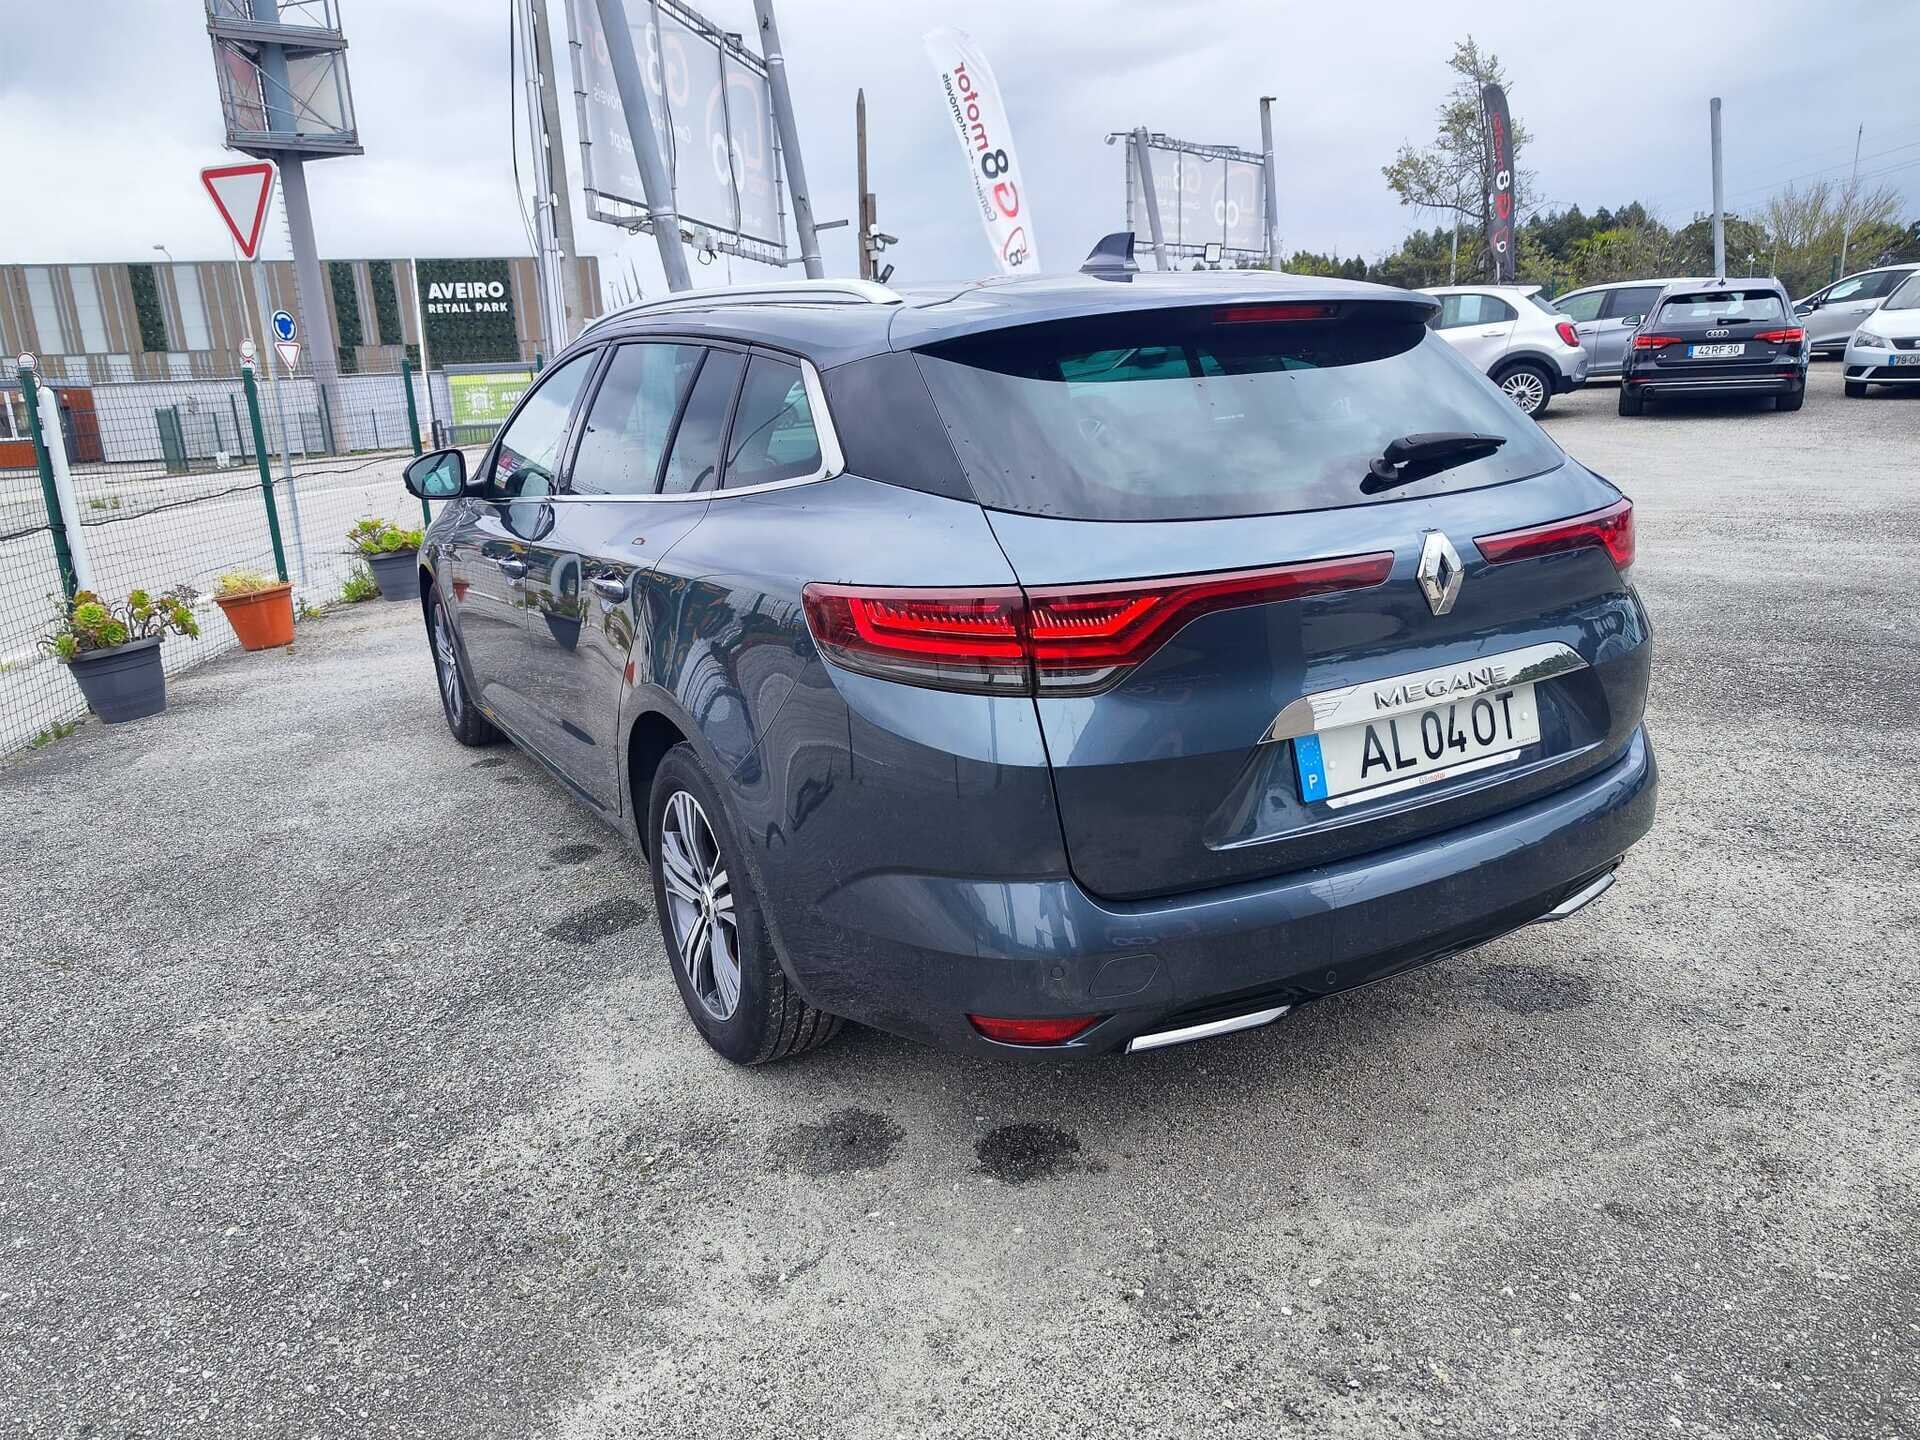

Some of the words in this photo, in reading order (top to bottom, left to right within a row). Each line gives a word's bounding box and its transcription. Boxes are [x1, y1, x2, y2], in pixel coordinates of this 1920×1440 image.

[428, 281, 505, 300] AVEIRO
[428, 303, 471, 313] RETAIL
[475, 302, 508, 312] PARK
[1375, 664, 1509, 710] MEGANE
